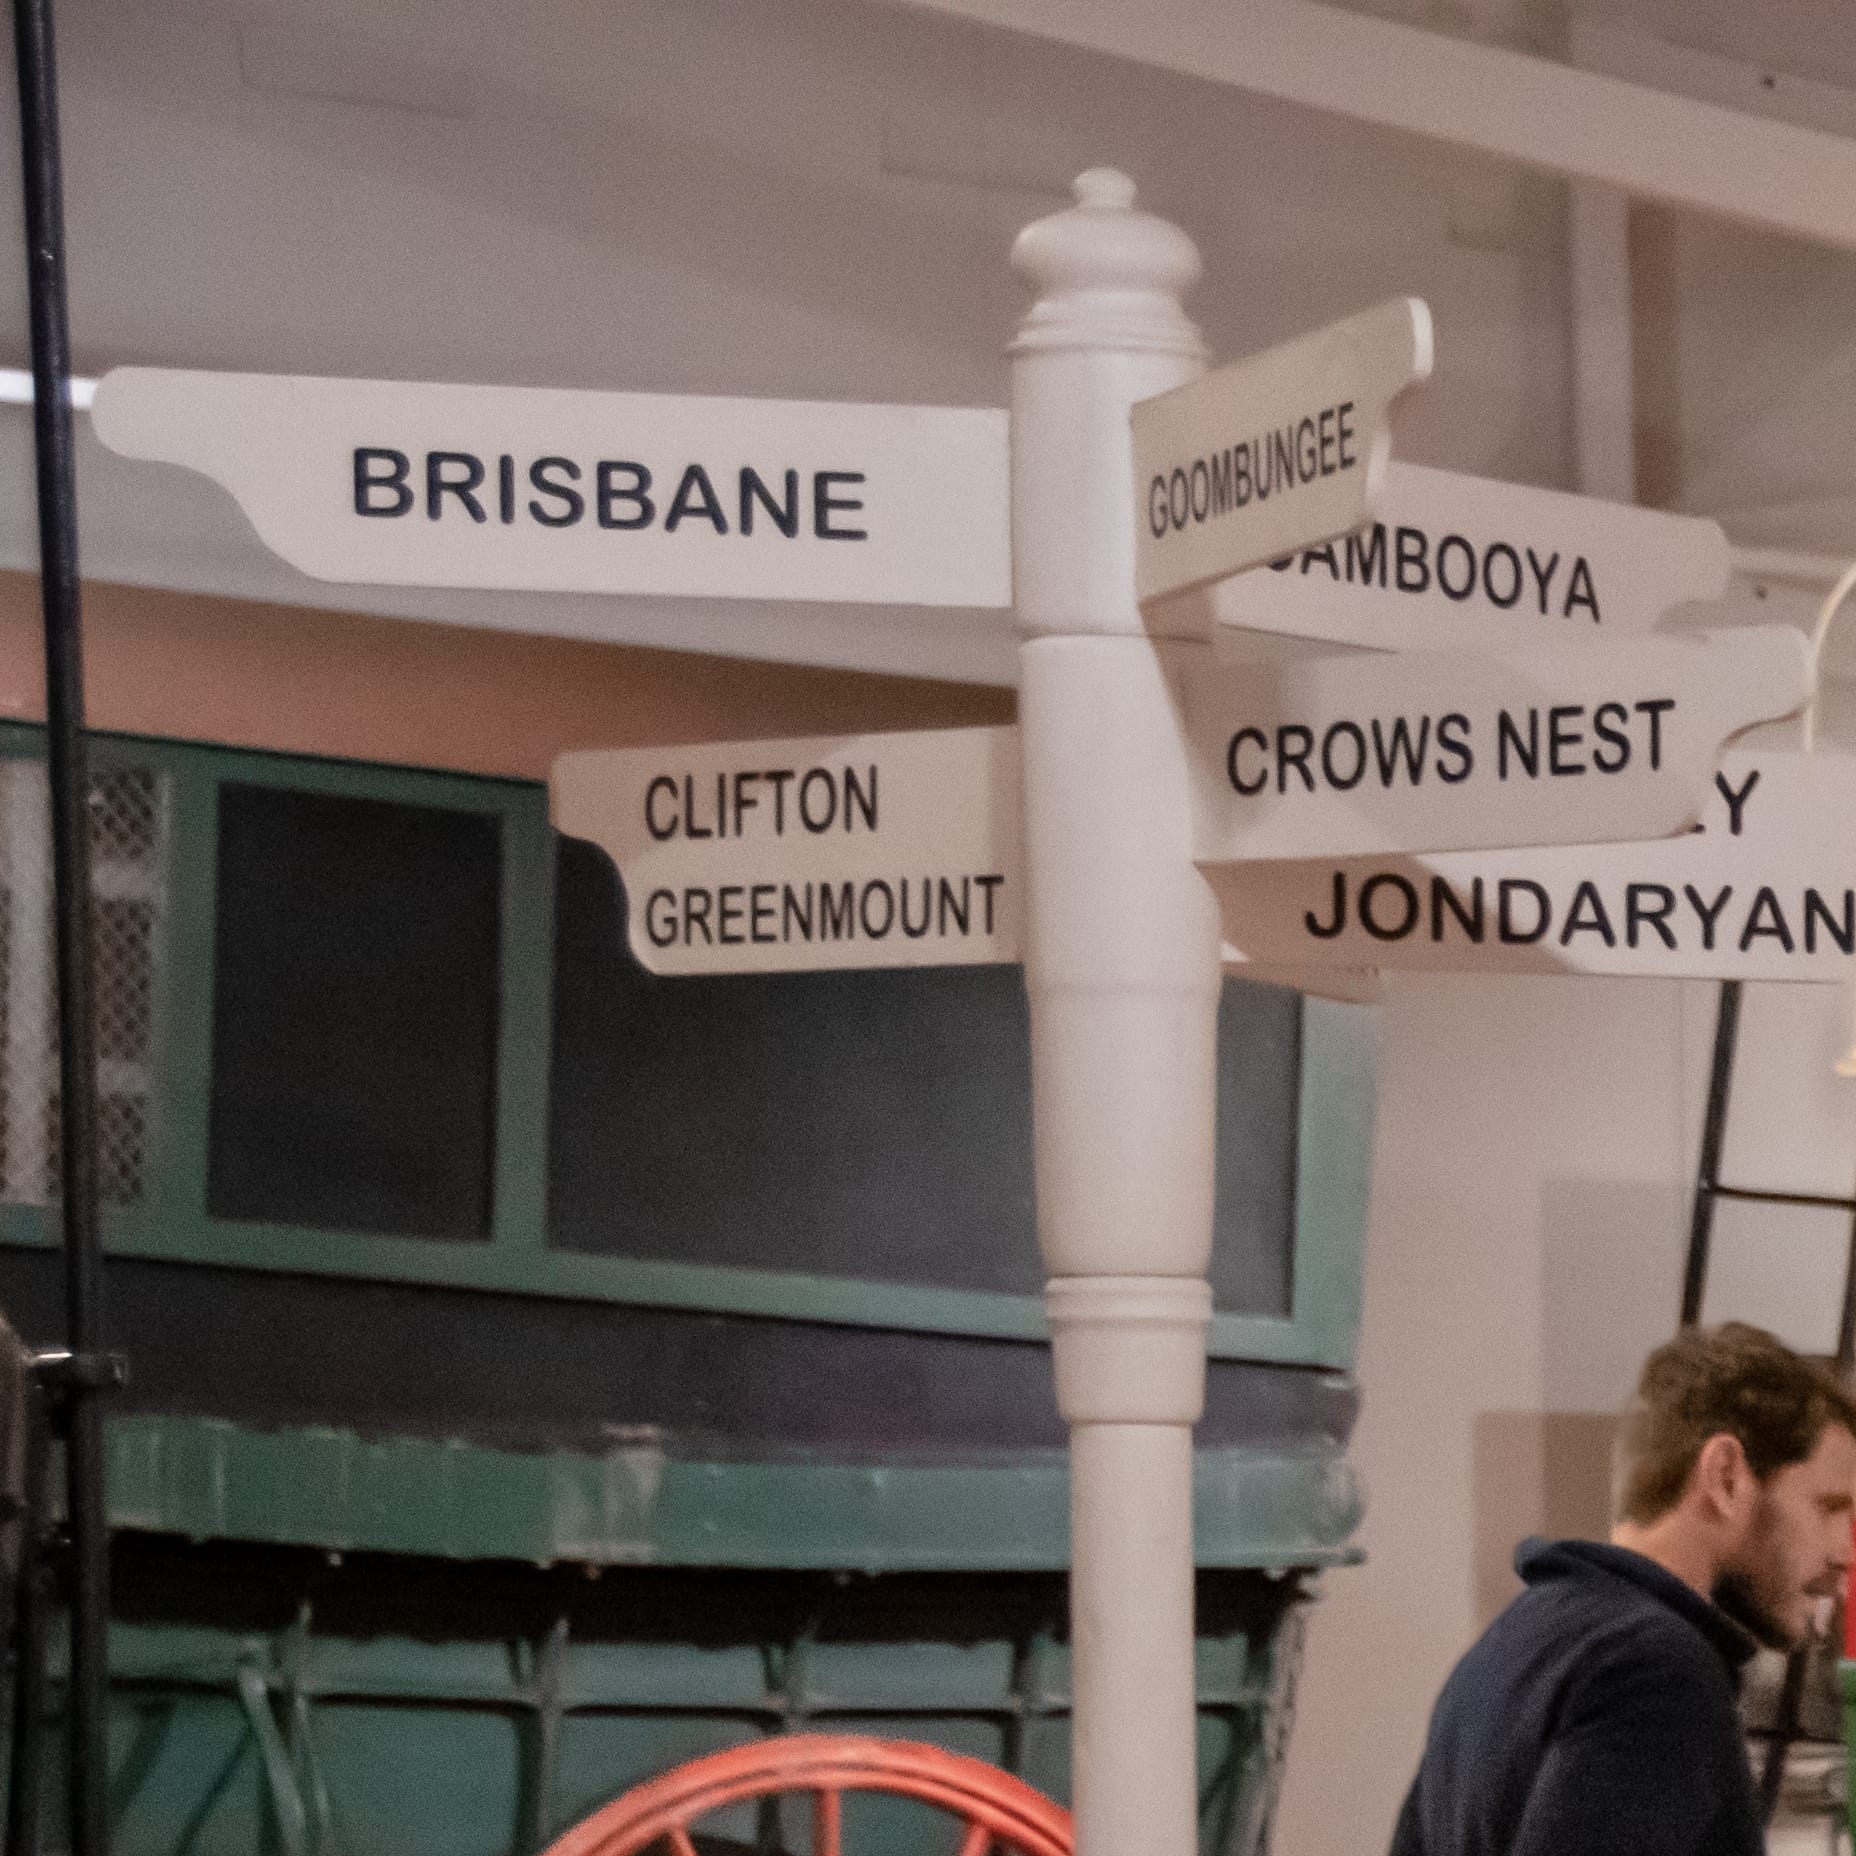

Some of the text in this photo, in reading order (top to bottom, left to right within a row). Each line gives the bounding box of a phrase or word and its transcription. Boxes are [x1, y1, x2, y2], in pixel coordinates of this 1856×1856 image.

[351, 446, 869, 541] BRISBANE
[1148, 400, 1357, 539] GOOMBUNGEE
[1267, 521, 1602, 624] AMBOOYA
[1225, 698, 1676, 797] CROWS NEST
[643, 765, 879, 842] CLIFTON
[643, 874, 1005, 949] GREENMOUNT
[1303, 872, 1856, 955] JONDARYAN
